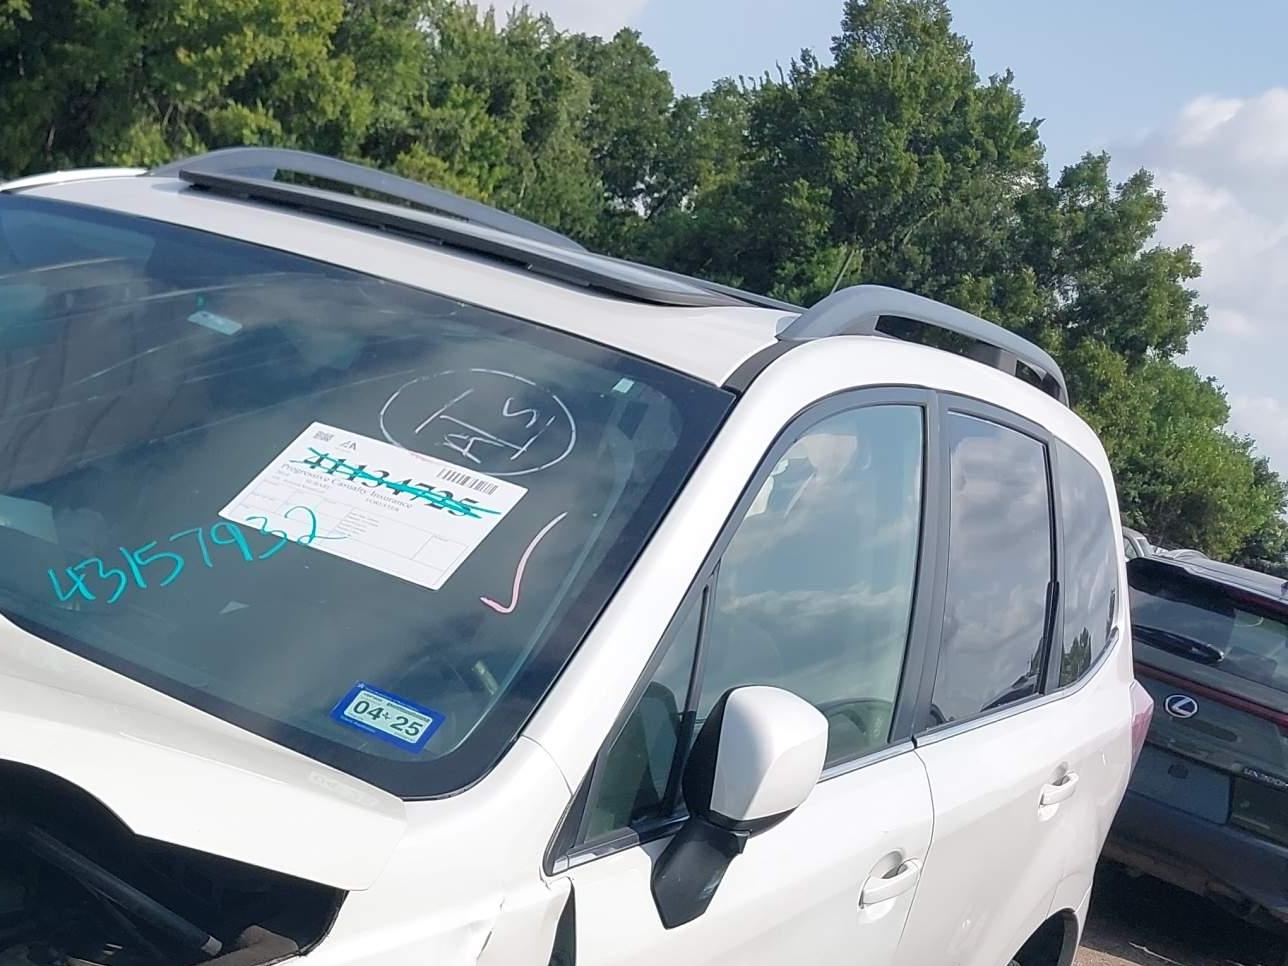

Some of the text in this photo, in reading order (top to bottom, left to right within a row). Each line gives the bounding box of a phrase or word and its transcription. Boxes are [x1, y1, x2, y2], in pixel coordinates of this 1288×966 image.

[280, 463, 331, 483] Progressive
[330, 478, 369, 497] Casualty
[370, 488, 414, 509] Insurance
[48, 505, 350, 604] 43157932
[353, 700, 385, 720] 04
[389, 716, 423, 736] 25
